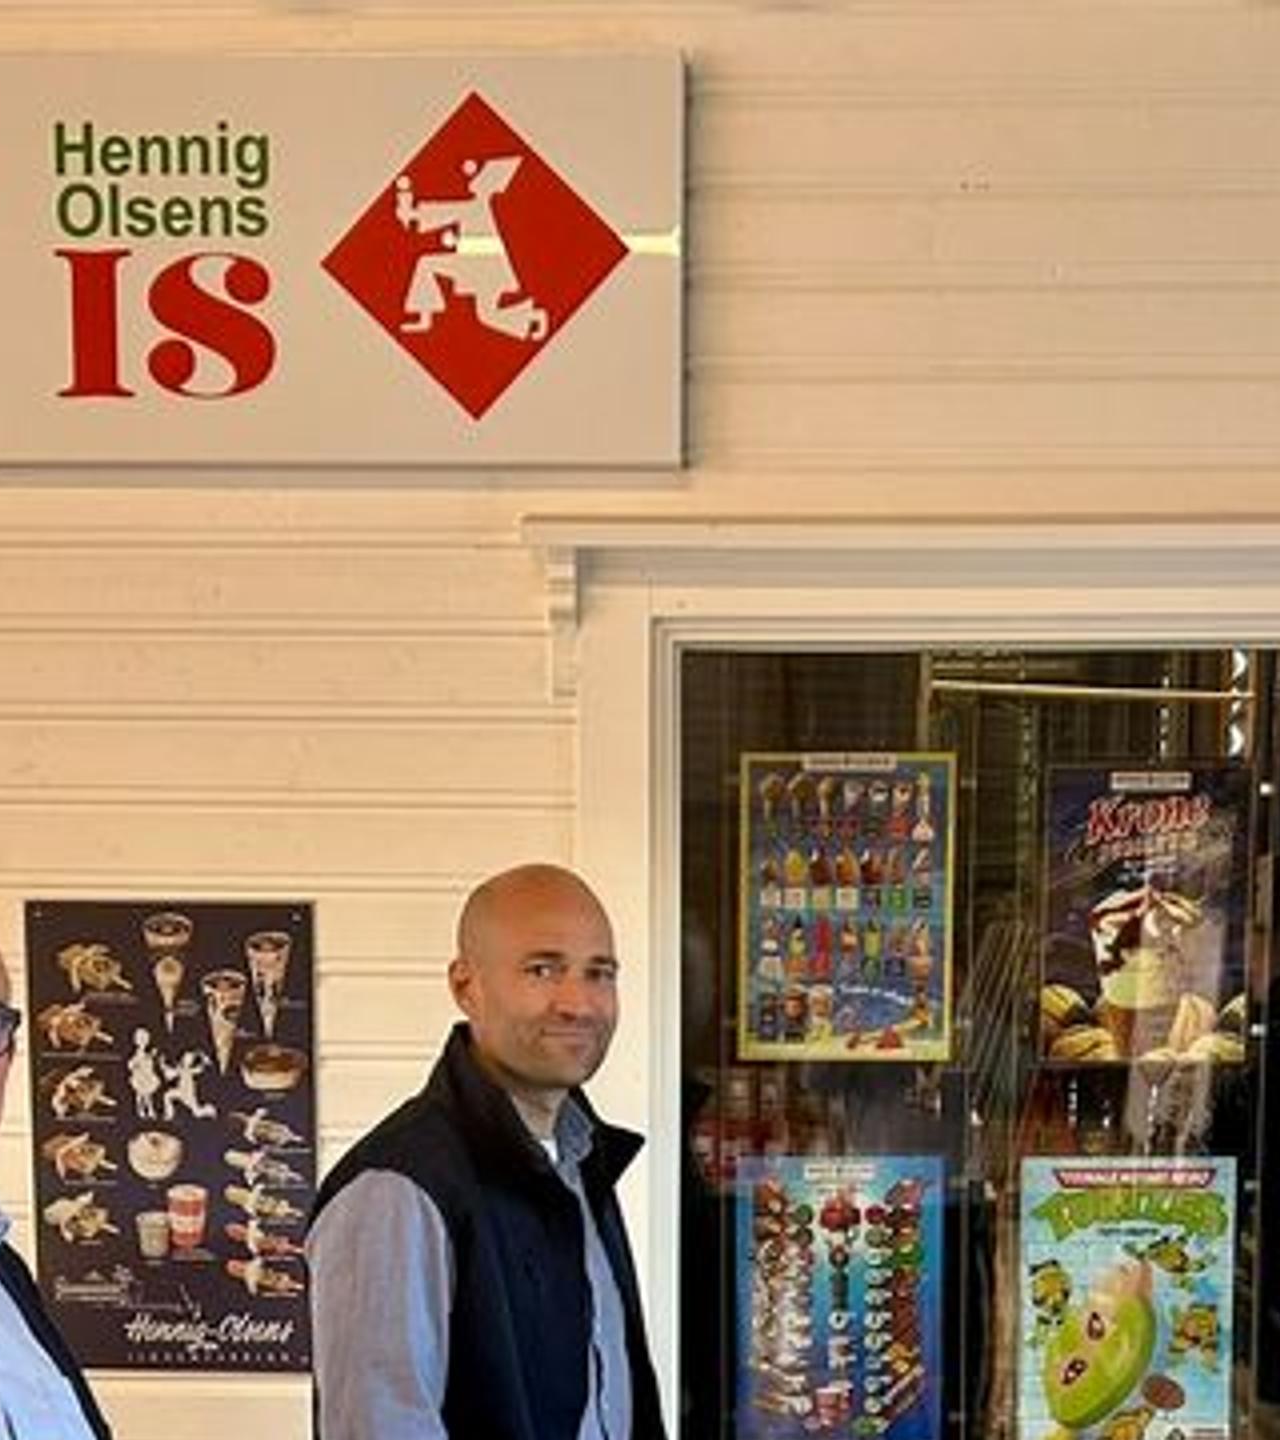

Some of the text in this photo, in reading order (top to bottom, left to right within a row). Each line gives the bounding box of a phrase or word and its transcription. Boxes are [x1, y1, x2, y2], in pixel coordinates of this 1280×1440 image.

[53, 121, 270, 189] Hennig
[56, 184, 268, 239] Olsens
[53, 247, 277, 399] IS
